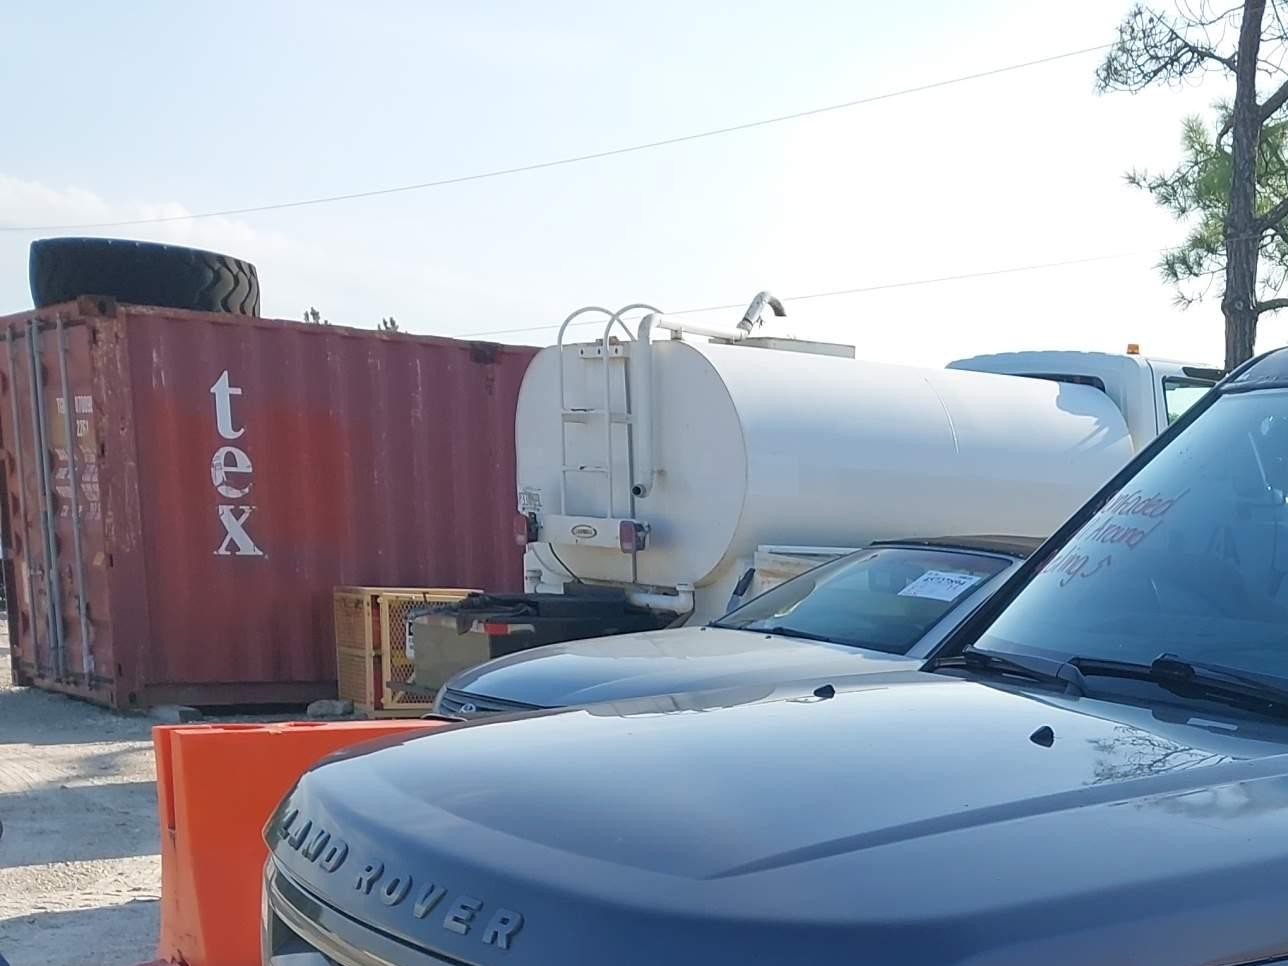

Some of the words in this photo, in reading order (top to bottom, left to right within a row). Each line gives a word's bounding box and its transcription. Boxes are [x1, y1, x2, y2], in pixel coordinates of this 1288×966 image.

[209, 369, 264, 556] tex
[278, 808, 350, 873] LAND
[353, 858, 525, 950] ROVER
